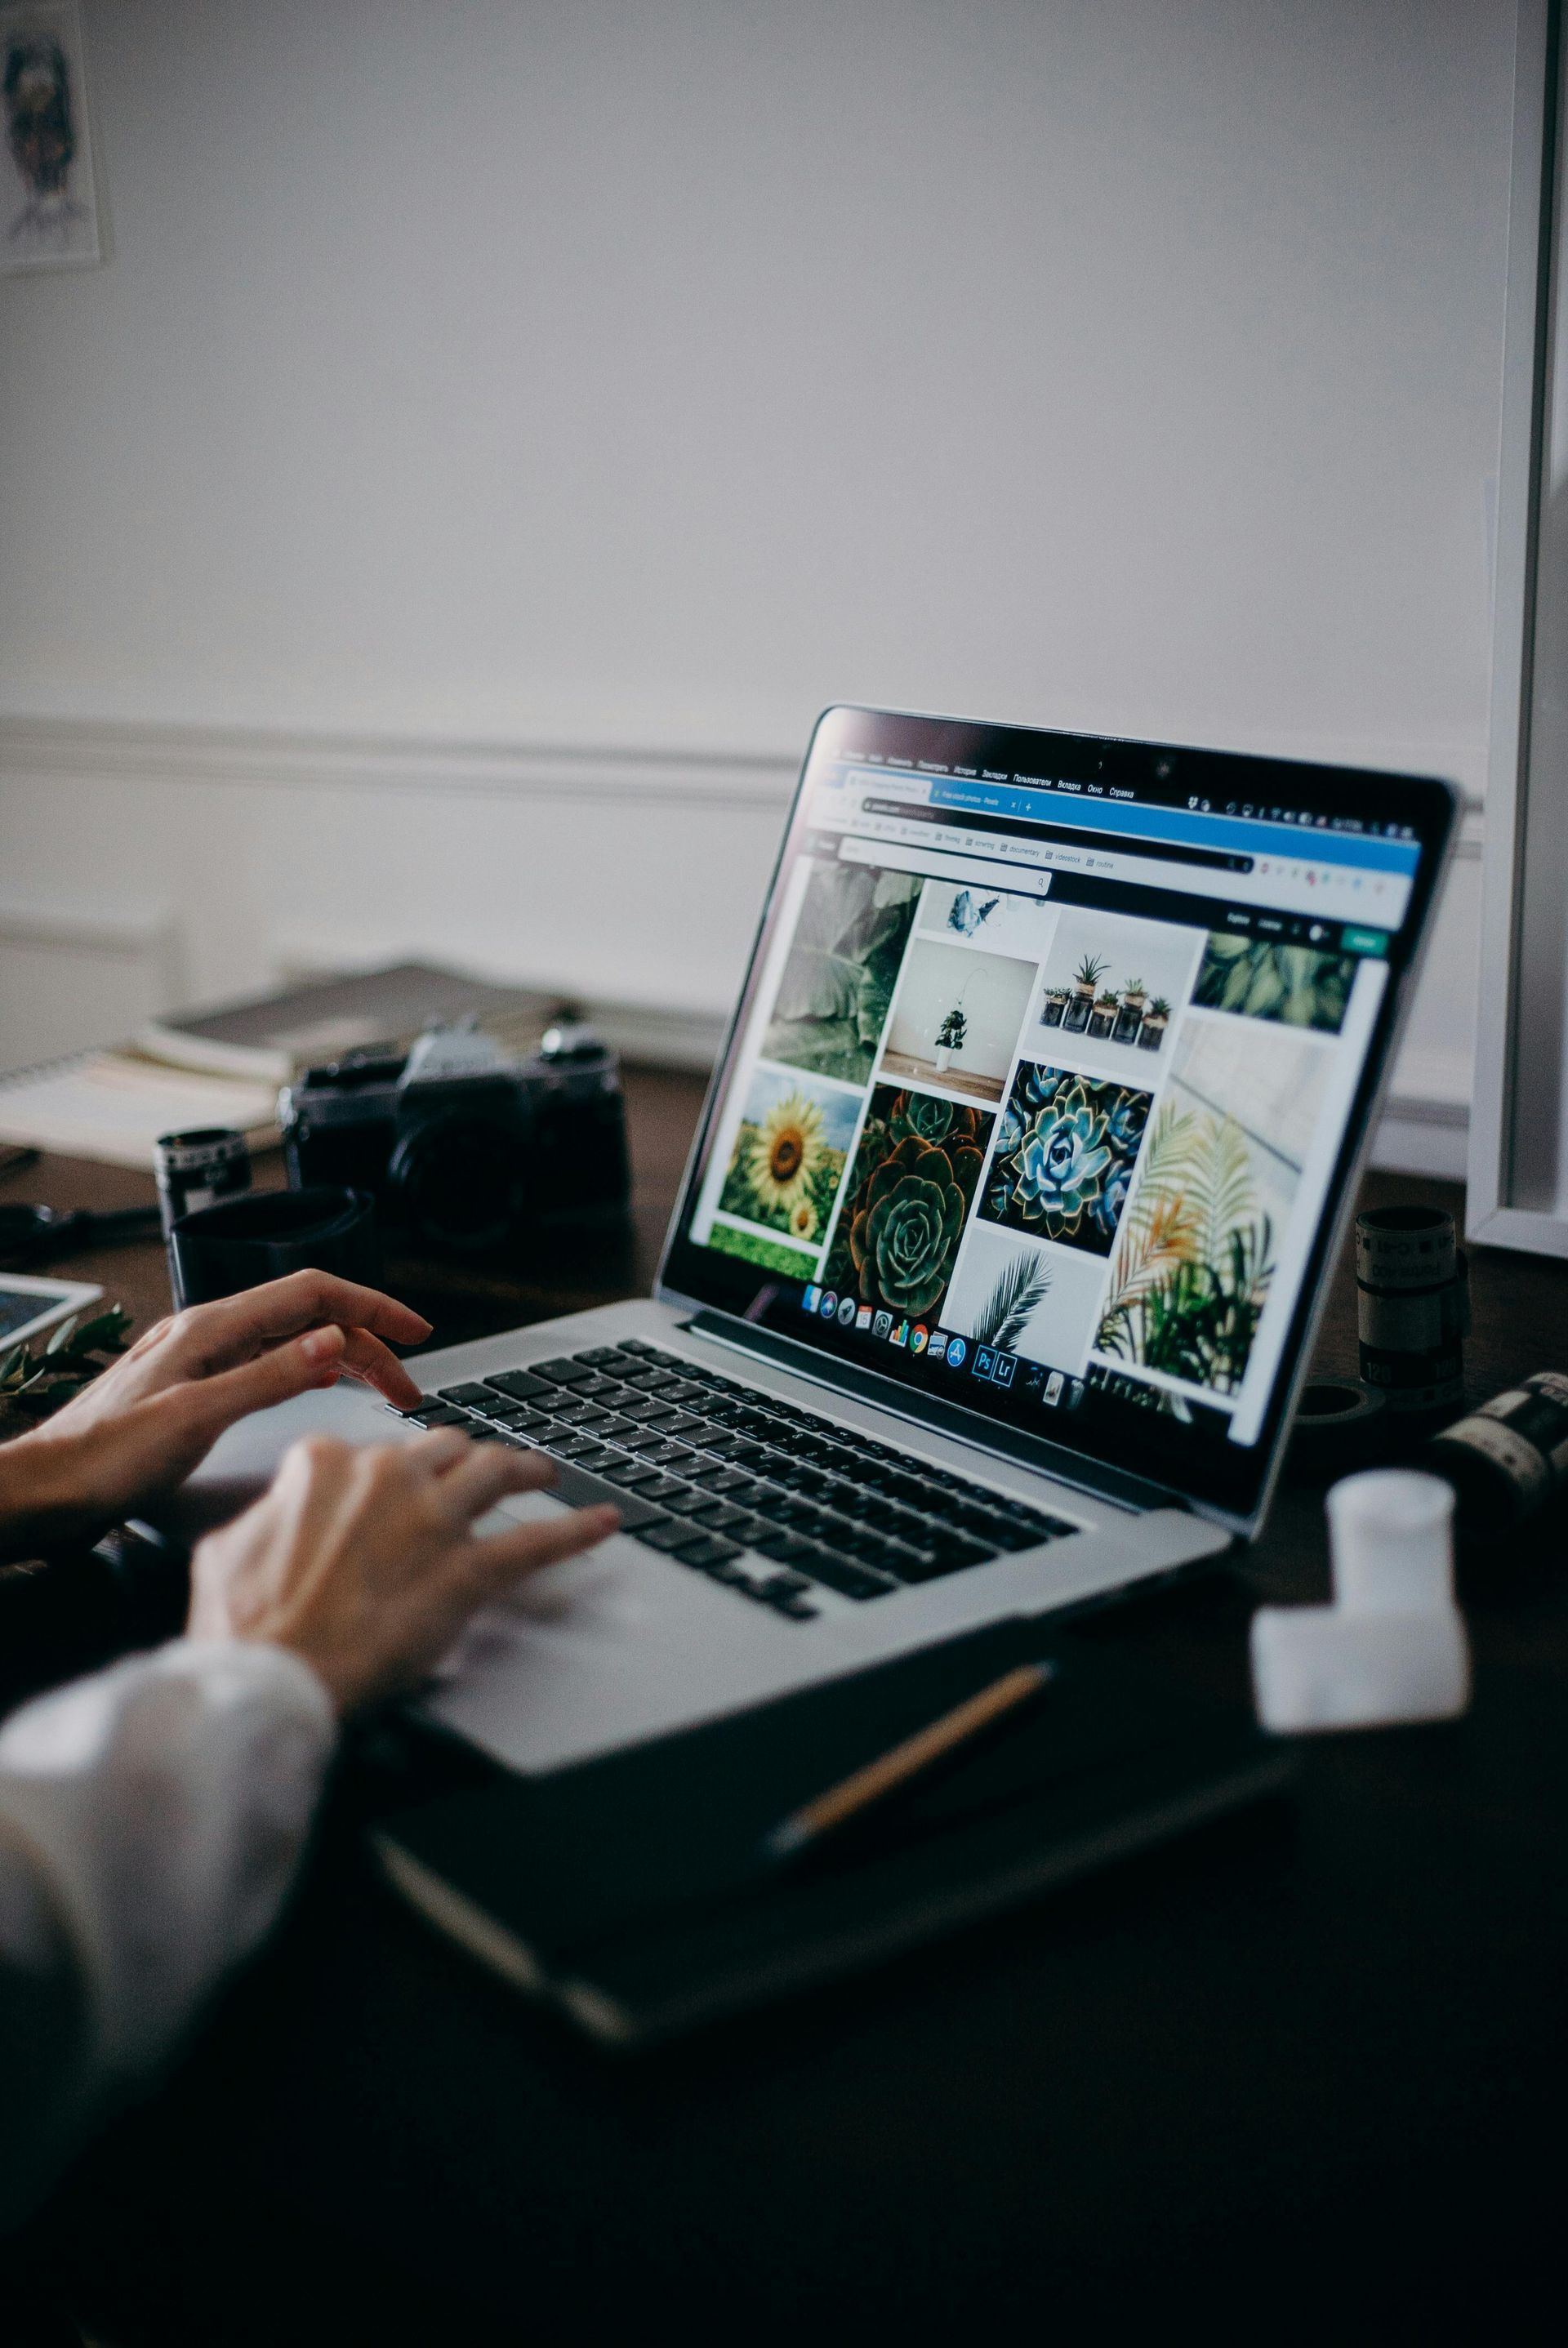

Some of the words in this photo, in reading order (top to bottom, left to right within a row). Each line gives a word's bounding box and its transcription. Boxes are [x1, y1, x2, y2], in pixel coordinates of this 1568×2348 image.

[982, 769, 1008, 781] Закладки
[1013, 773, 1052, 786] Пользователи
[1057, 779, 1081, 791] Вкладка
[1087, 784, 1103, 794] Окно
[1109, 786, 1135, 799] Справка
[1009, 844, 1040, 858] documentary
[1095, 859, 1115, 870] routine
[858, 1313, 869, 1326] 15
[978, 1352, 991, 1370] Ps
[998, 1358, 1011, 1377] Lr
[1366, 1361, 1392, 1383] 120
[660, 1442, 675, 1450] G
